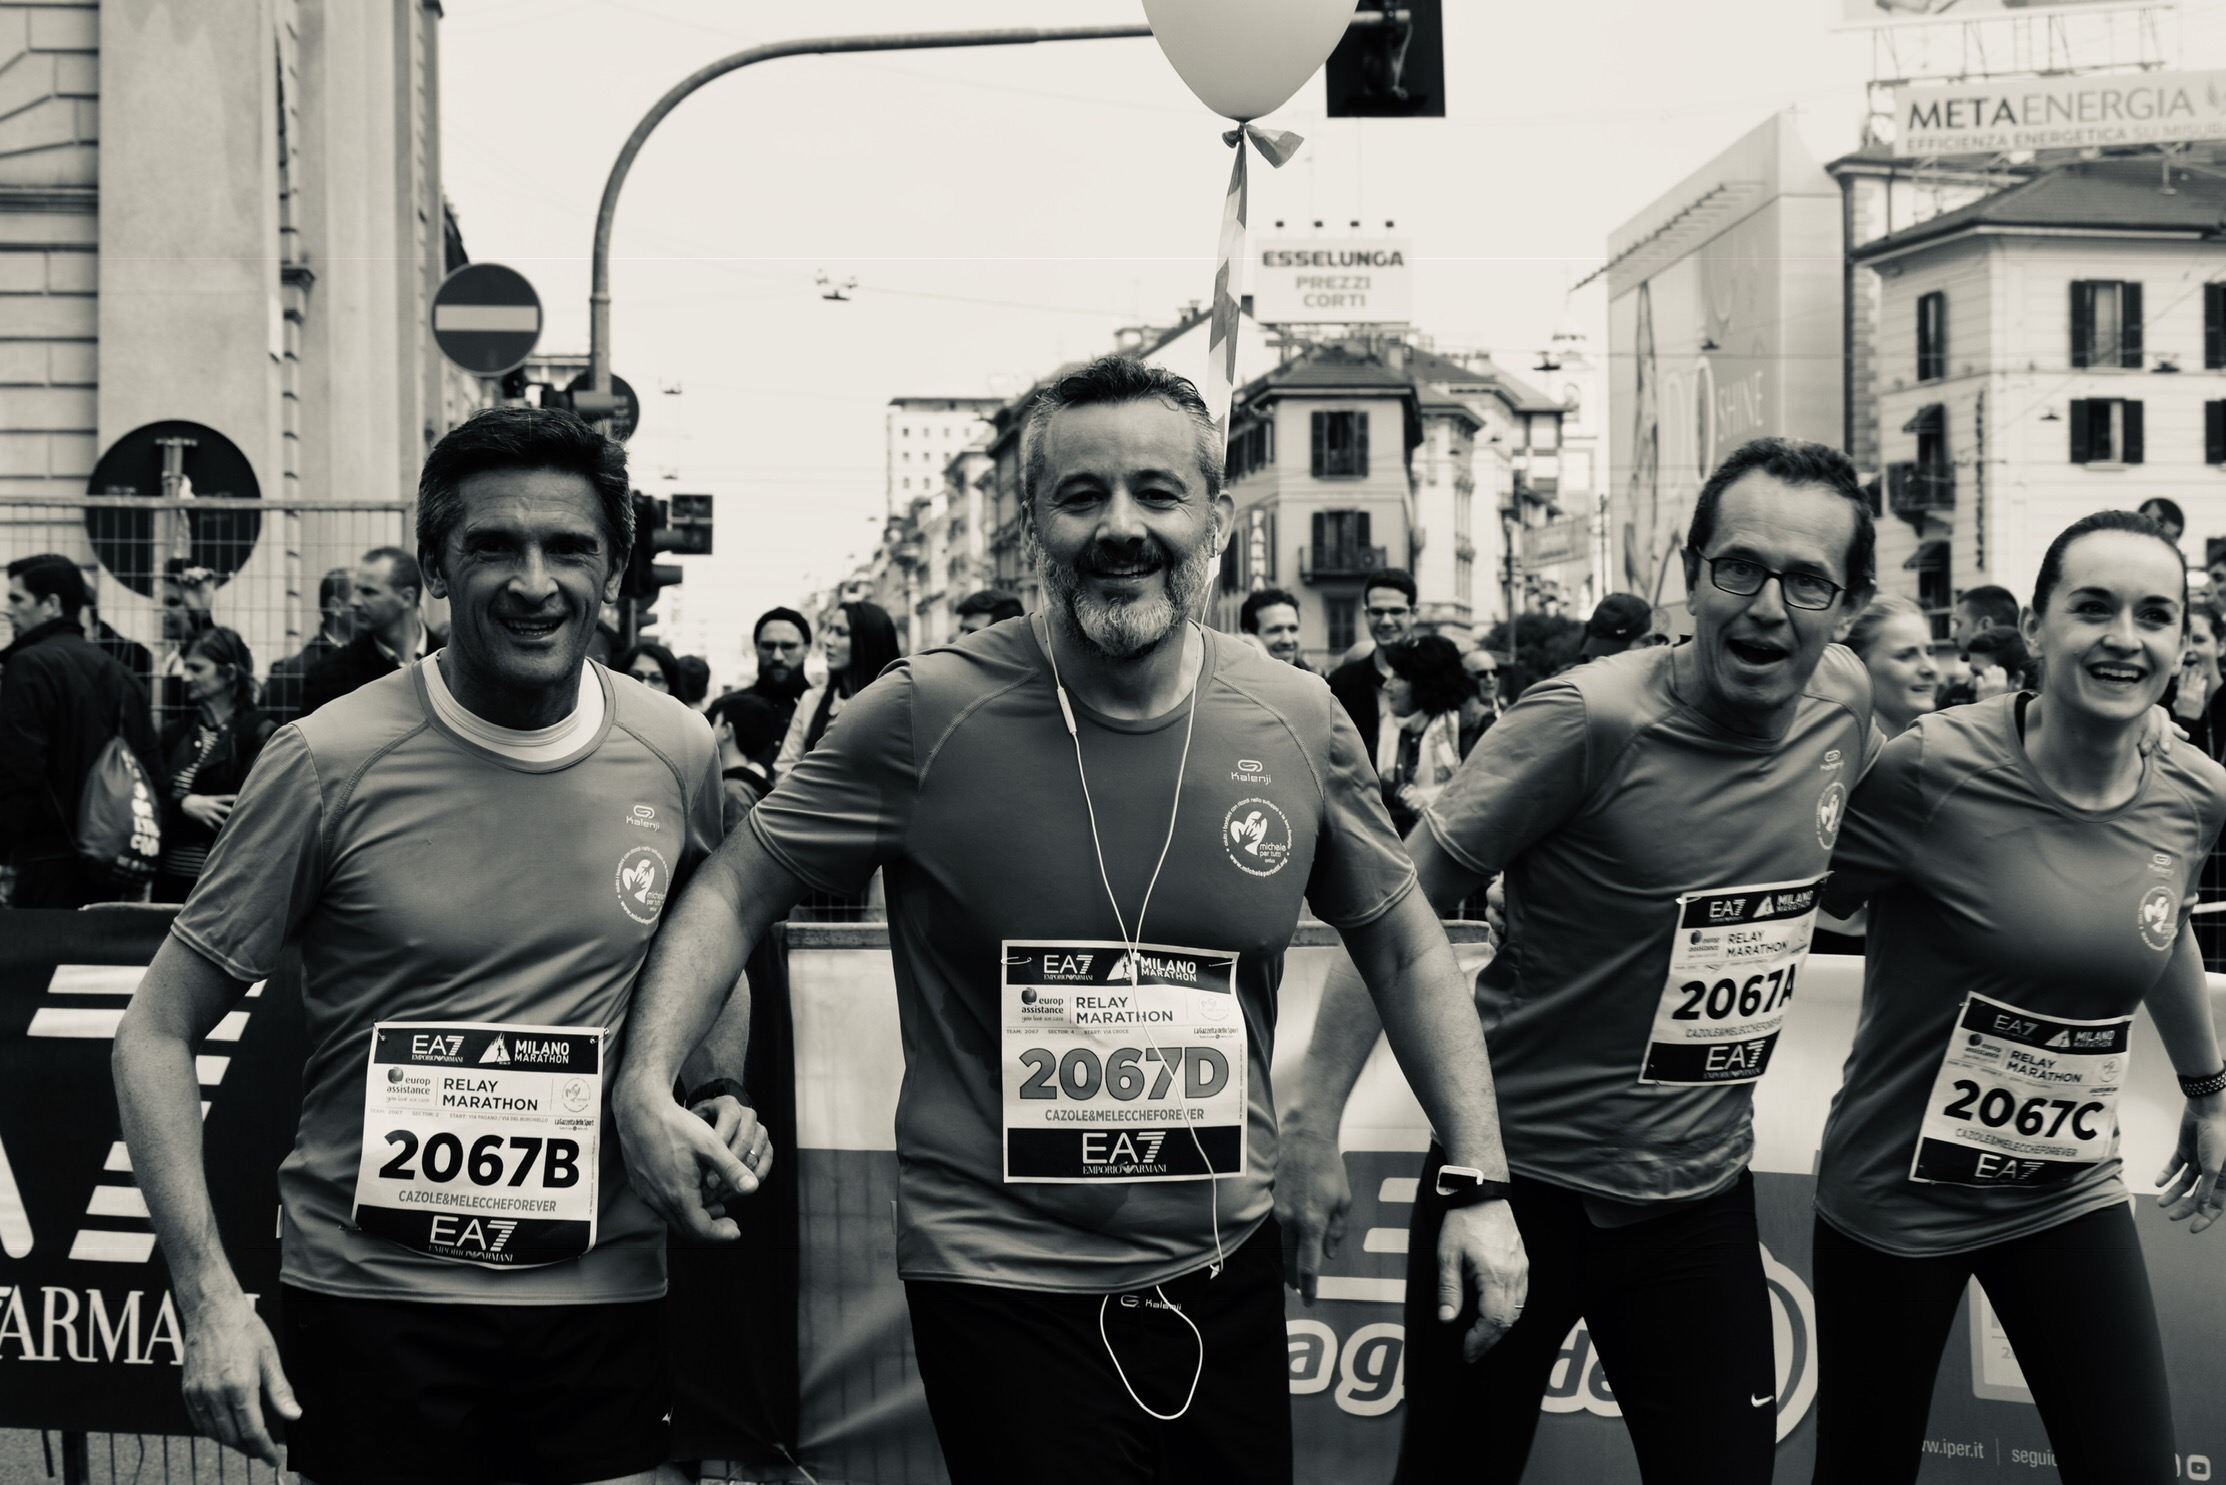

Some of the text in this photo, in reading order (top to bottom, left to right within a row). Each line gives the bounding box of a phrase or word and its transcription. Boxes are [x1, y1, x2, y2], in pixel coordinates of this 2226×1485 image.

[1908, 88, 2196, 130] METAENERGIA
[1907, 134, 2008, 151] EFFICIENZA
[2014, 126, 2127, 148] ENERGETICA
[1262, 251, 1404, 267] ESSELUNGA
[1296, 276, 1371, 289] PREZZI
[1303, 293, 1366, 308] CORTI
[1231, 772, 1272, 785] Kalenji
[626, 815, 660, 831] Kalenji
[1260, 842, 1286, 852] michele
[1777, 890, 1814, 905] MILANO
[1709, 899, 1746, 918] EA7
[1728, 930, 1765, 944] RELAY
[1726, 941, 1788, 958] MARATHON
[1044, 954, 1094, 975] EA7
[1141, 957, 1196, 974] MILANO
[1141, 967, 1197, 982] MARATHON
[1671, 963, 1796, 1020] 2067A
[1021, 1005, 1064, 1014] assistance
[1039, 997, 1064, 1006] europ
[1076, 997, 1128, 1008] RELAY
[1076, 1011, 1173, 1024] MARATHON
[1993, 1014, 2038, 1036] EA7
[2074, 1030, 2116, 1041] MILANO
[411, 1035, 464, 1056] EA7
[515, 1039, 569, 1056] MILANO
[514, 1053, 569, 1064] MARATHON
[1705, 1039, 1766, 1071] EA7
[2010, 1050, 2057, 1069] RELAY
[1019, 1047, 1229, 1101] 2067D
[2006, 1061, 2083, 1083] MARATHON
[405, 1077, 431, 1086] europ
[443, 1078, 499, 1092] RELAY
[387, 1085, 430, 1095] assistance
[443, 1095, 538, 1111] MARATHON
[1944, 1079, 2104, 1140] 2067C
[1082, 1131, 1167, 1164] EA7
[378, 1129, 580, 1189] 2067B
[1974, 1153, 2045, 1179] EA7
[1083, 1164, 1167, 1174] EMPORIO ARMANI
[430, 1215, 518, 1252] EA7
[480, 1250, 514, 1263] ARMANI
